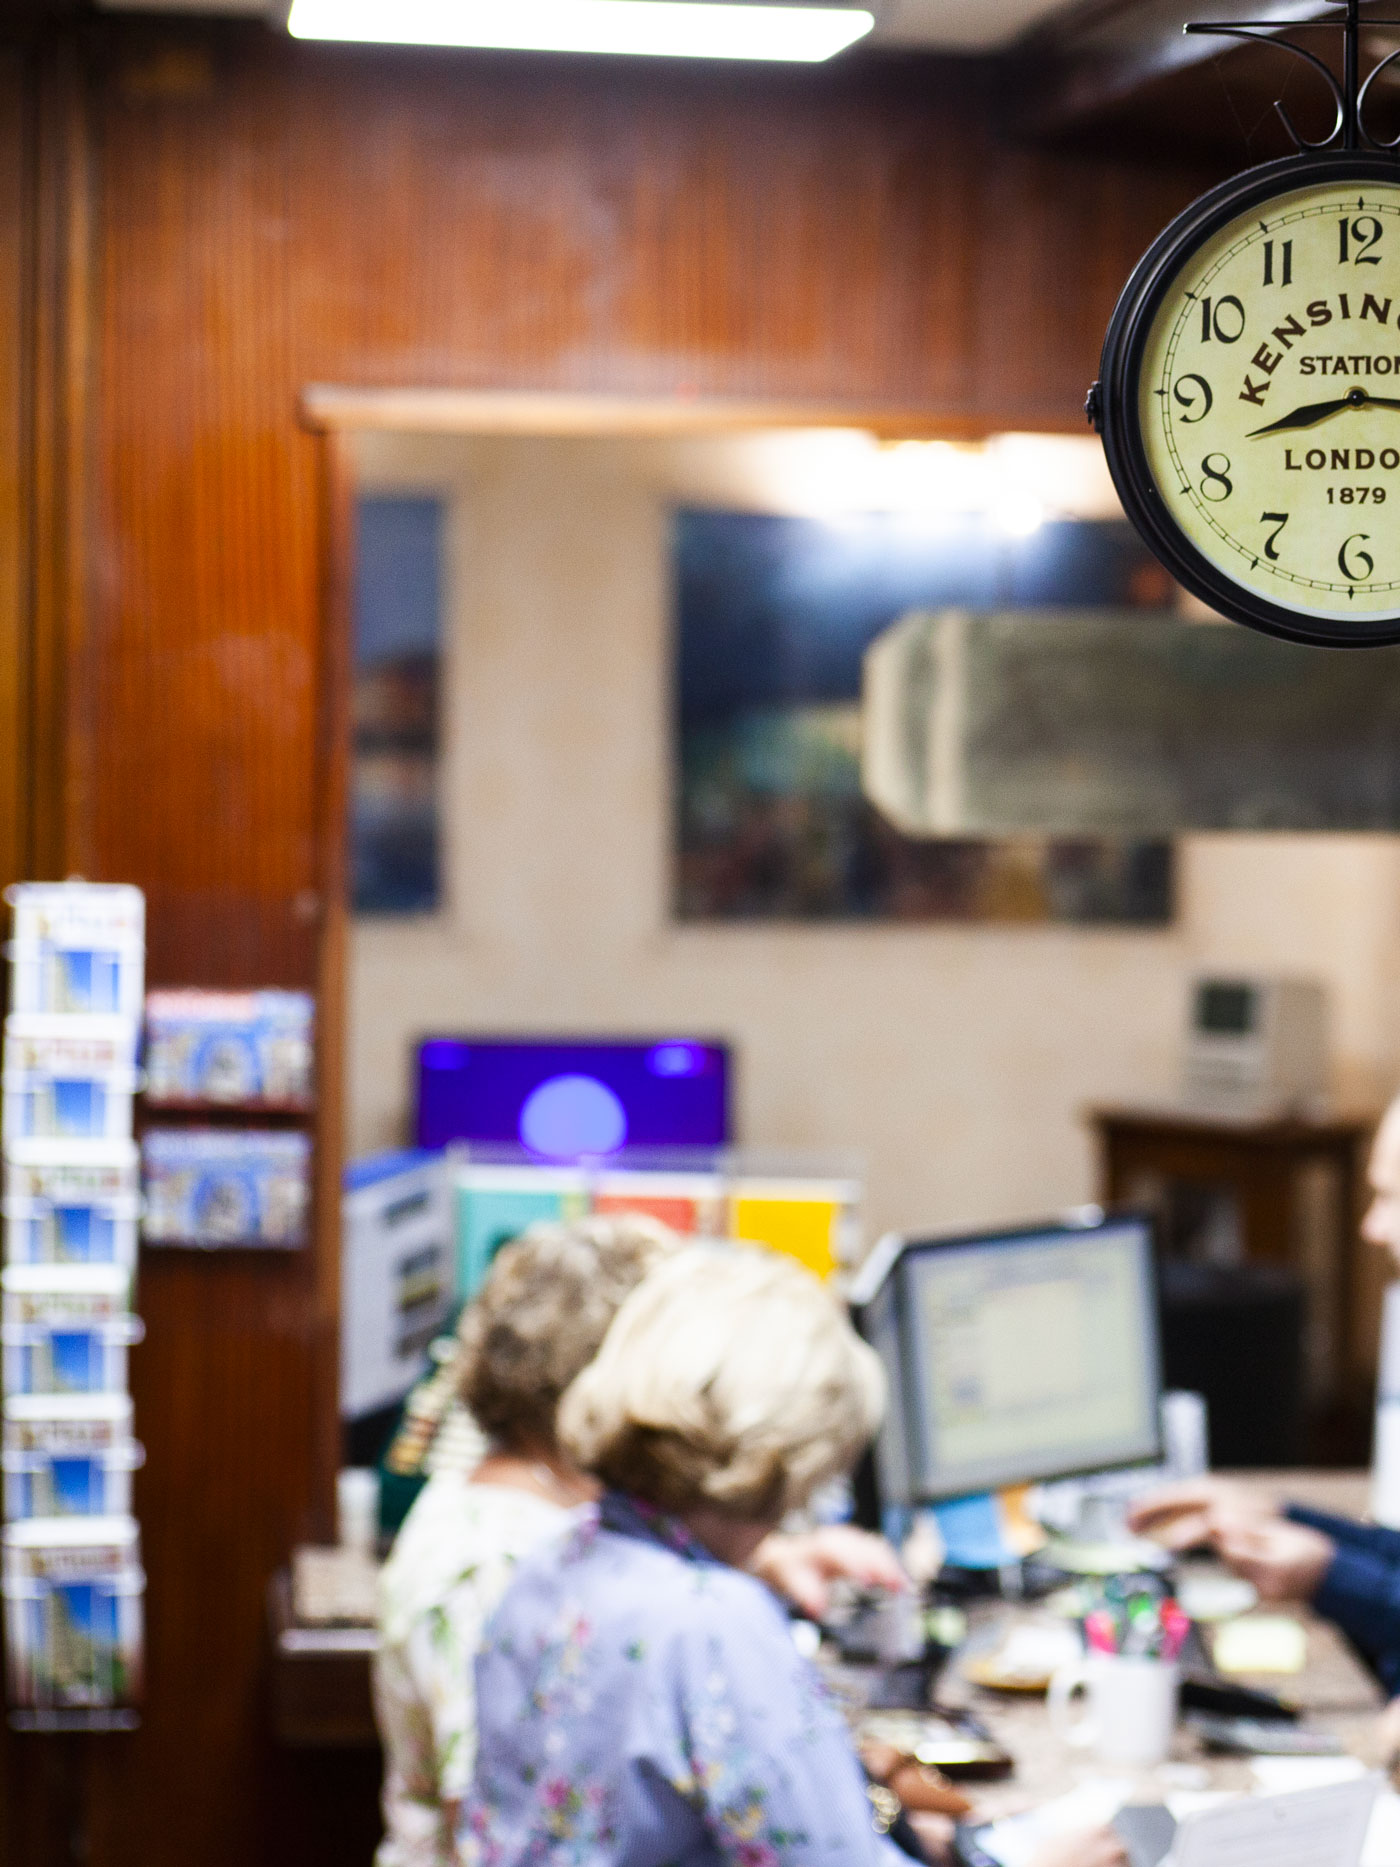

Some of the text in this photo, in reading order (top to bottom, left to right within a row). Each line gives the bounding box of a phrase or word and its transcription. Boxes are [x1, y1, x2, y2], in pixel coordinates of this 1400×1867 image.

[1262, 239, 1293, 288] 11
[1338, 216, 1384, 266] 12
[1200, 295, 1246, 344] 10
[1173, 374, 1213, 423] 9
[1199, 453, 1233, 502] 8
[1326, 487, 1387, 505] 1879
[1260, 512, 1289, 561] 7
[1338, 534, 1374, 582] 6
